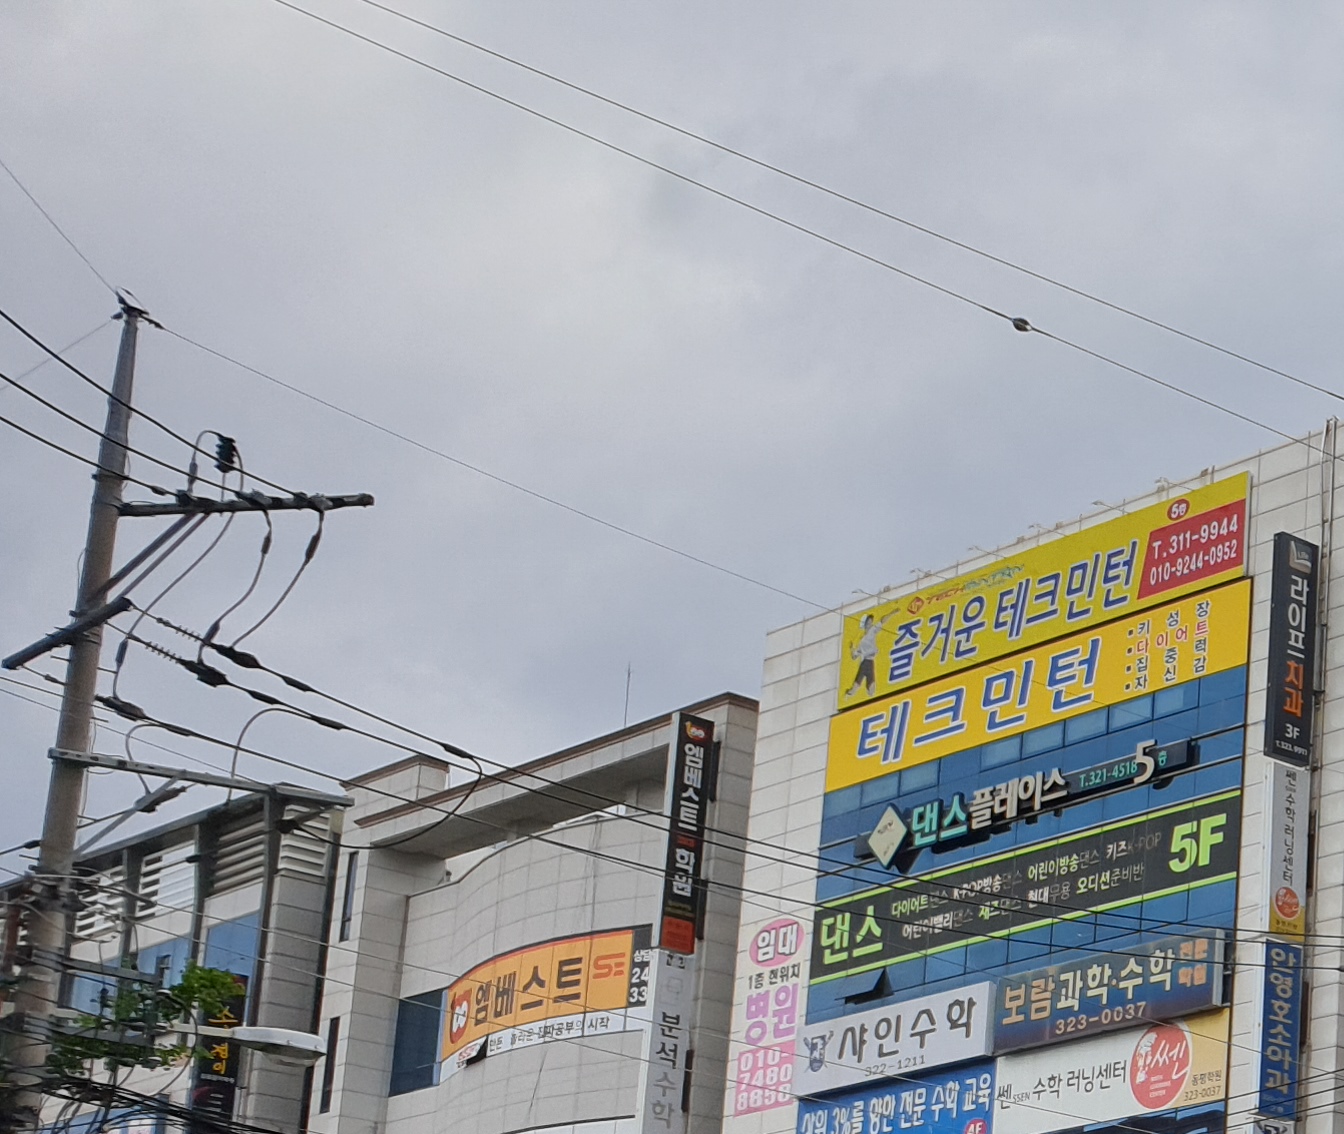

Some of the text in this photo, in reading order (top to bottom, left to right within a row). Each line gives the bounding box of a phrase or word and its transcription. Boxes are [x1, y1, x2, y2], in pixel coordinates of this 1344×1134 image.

[1149, 543, 1238, 587] 010-9244-0952
[888, 597, 986, 684] 즐거운
[993, 540, 1138, 641] 테크민턴
[856, 638, 1101, 764] 테크민턴
[1285, 723, 1300, 739] 3F
[1079, 760, 1138, 789] T.321-4518
[1168, 813, 1228, 873] 5F
[1076, 862, 1145, 895] 오디션준비반
[757, 922, 799, 962] 임대
[820, 905, 884, 965] 댄스
[474, 957, 583, 1026] 엠베스트
[769, 963, 801, 985] 현위치
[588, 1016, 610, 1030] 시작
[745, 983, 799, 1046] 병원
[837, 996, 977, 1063] 샤인수학
[1055, 1002, 1147, 1035] 323-0037
[864, 1055, 926, 1077] 322-1211
[1032, 1074, 1062, 1100] 수학
[1066, 1059, 1127, 1093] 러닝센터
[900, 1088, 926, 1129] 전문
[931, 1080, 960, 1122] 수학
[963, 1073, 992, 1112] 교육
